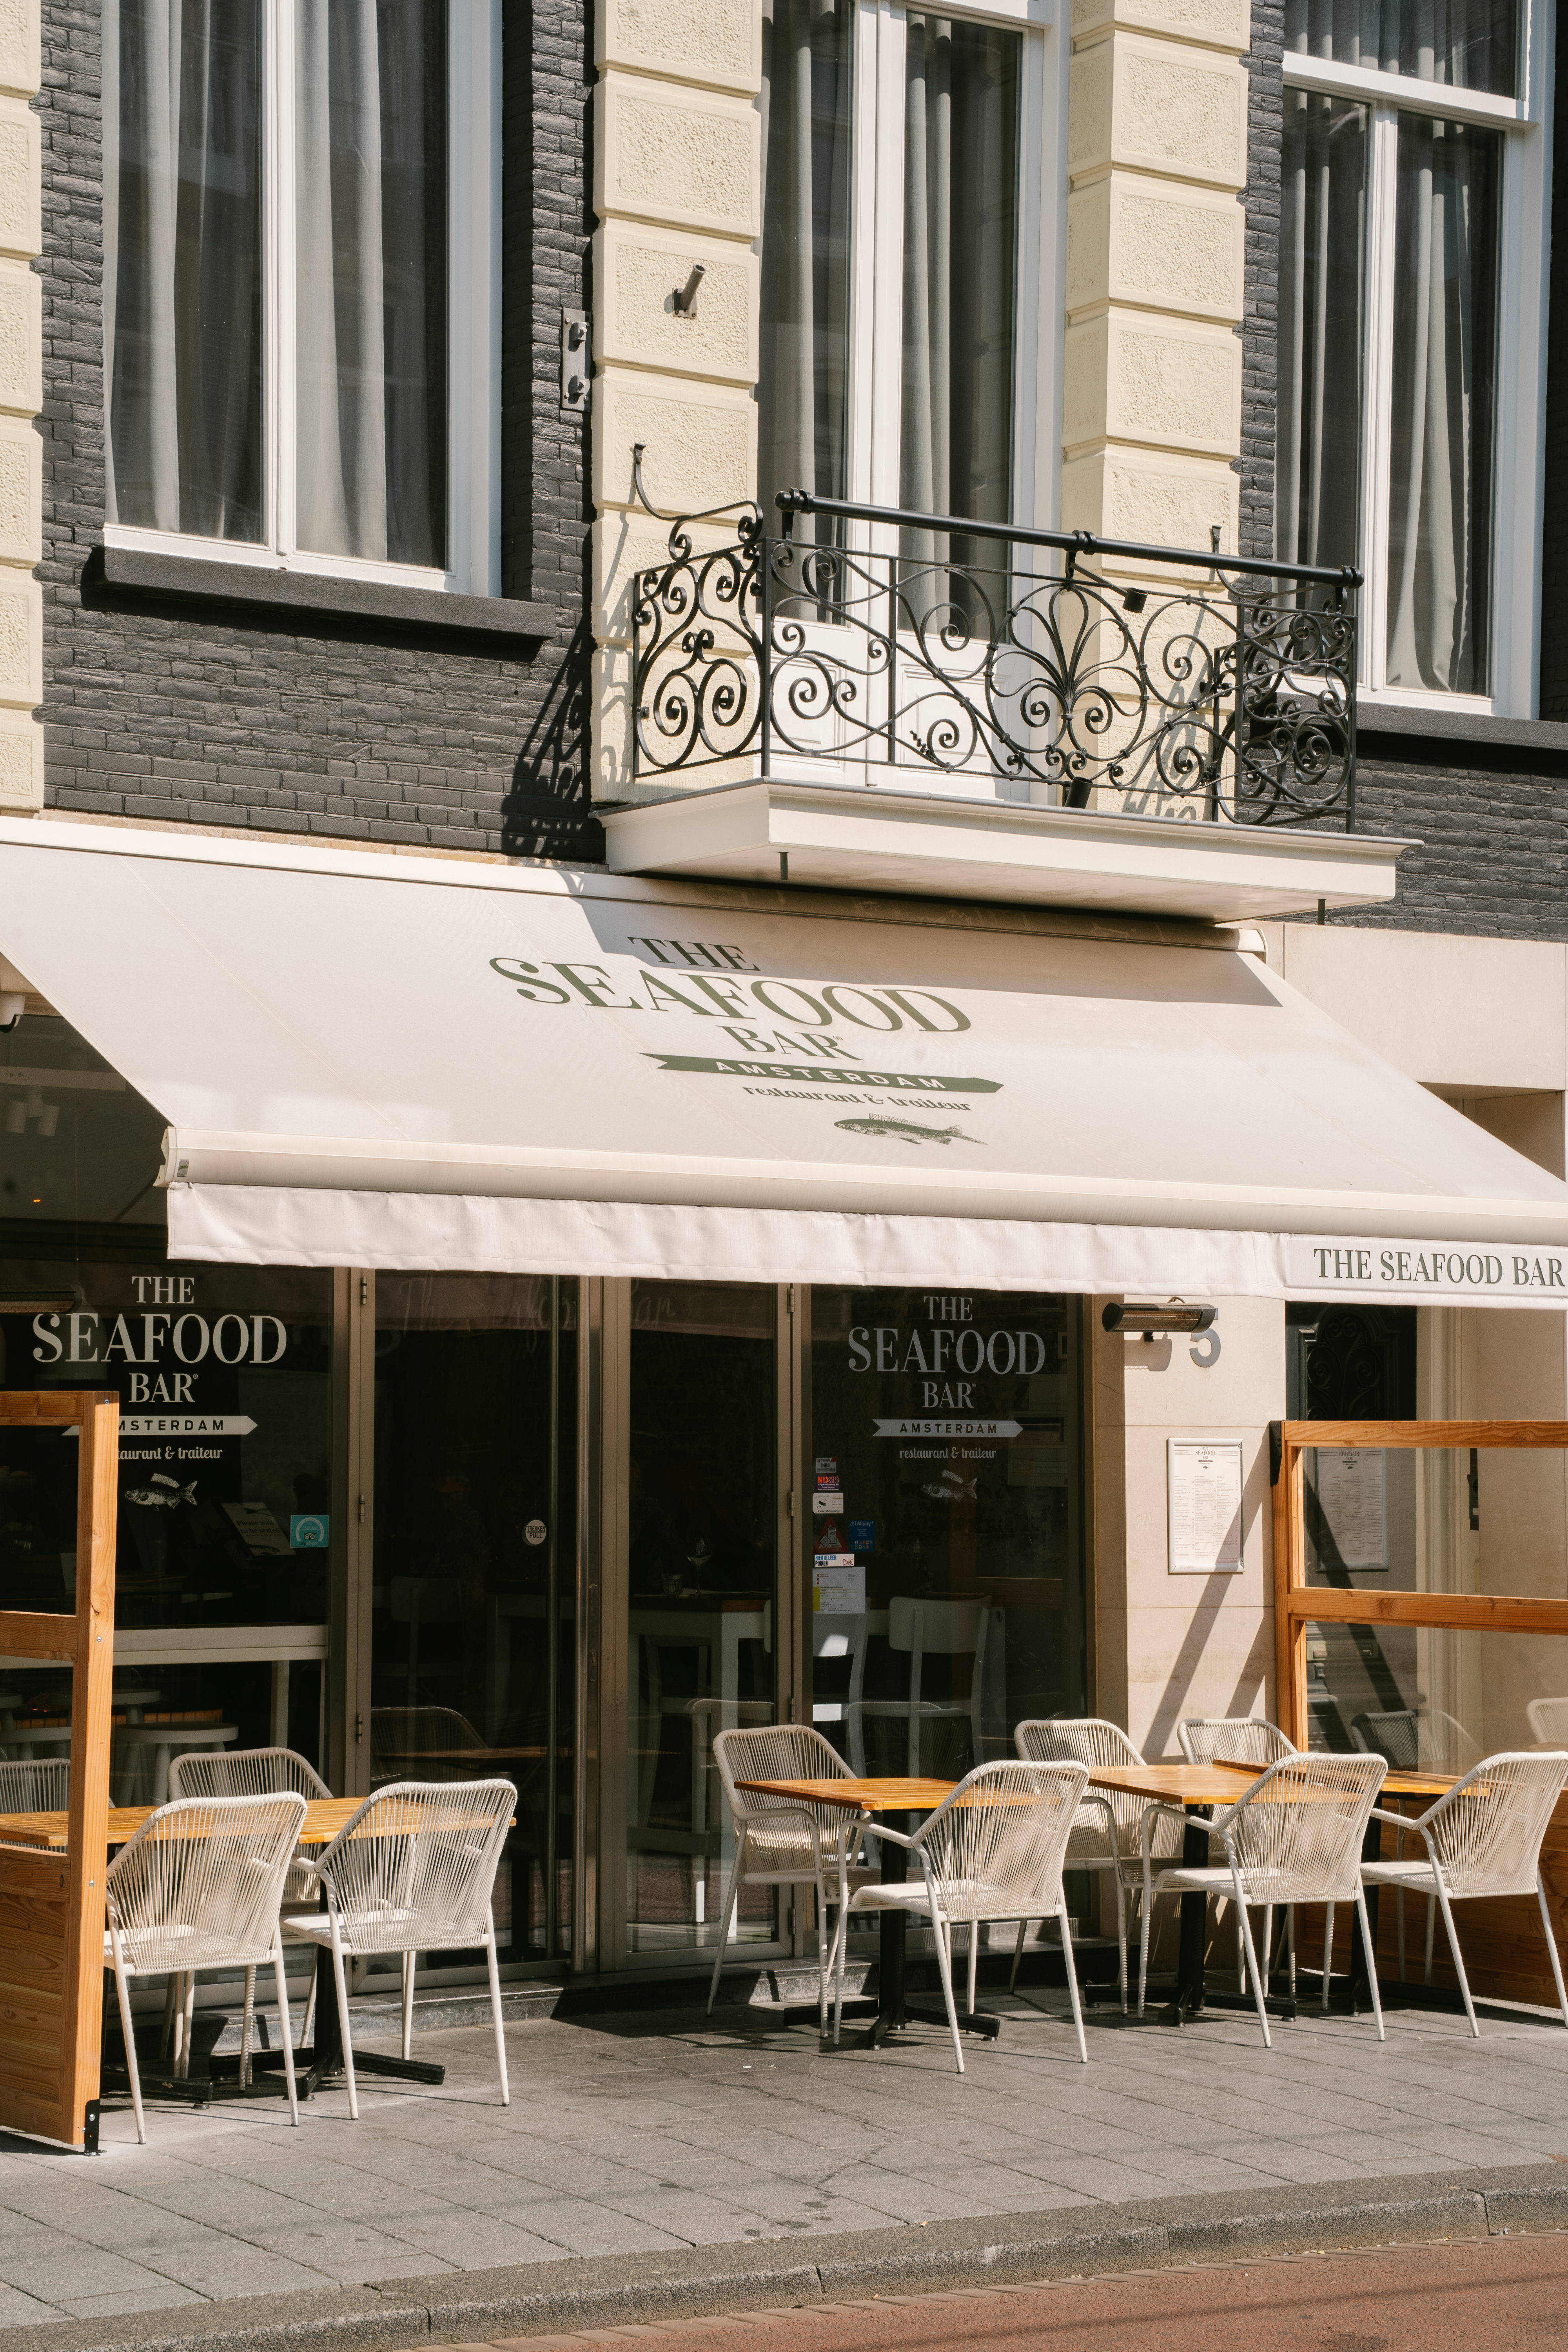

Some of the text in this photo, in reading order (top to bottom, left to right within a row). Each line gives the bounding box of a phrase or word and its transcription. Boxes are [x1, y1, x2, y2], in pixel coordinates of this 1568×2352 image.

[627, 936, 761, 972] THE
[489, 957, 971, 1033] SEAFOOD
[716, 1062, 946, 1089] AMSTERDAM
[742, 1087, 973, 1111] restaurant & traiteur
[1314, 1249, 1566, 1287] THE SEAFOOD BAR
[132, 1276, 194, 1304] THE
[924, 1296, 972, 1321] THE
[33, 1313, 287, 1363] SEAFOOD
[848, 1327, 1045, 1374] SEAFOOD
[118, 1420, 223, 1431] MSTERDAM
[900, 1423, 997, 1434] AMSTERDAM
[165, 1446, 175, 1459] &
[178, 1446, 223, 1459] traiteur
[900, 1446, 996, 1459] restaurant & traiteur
